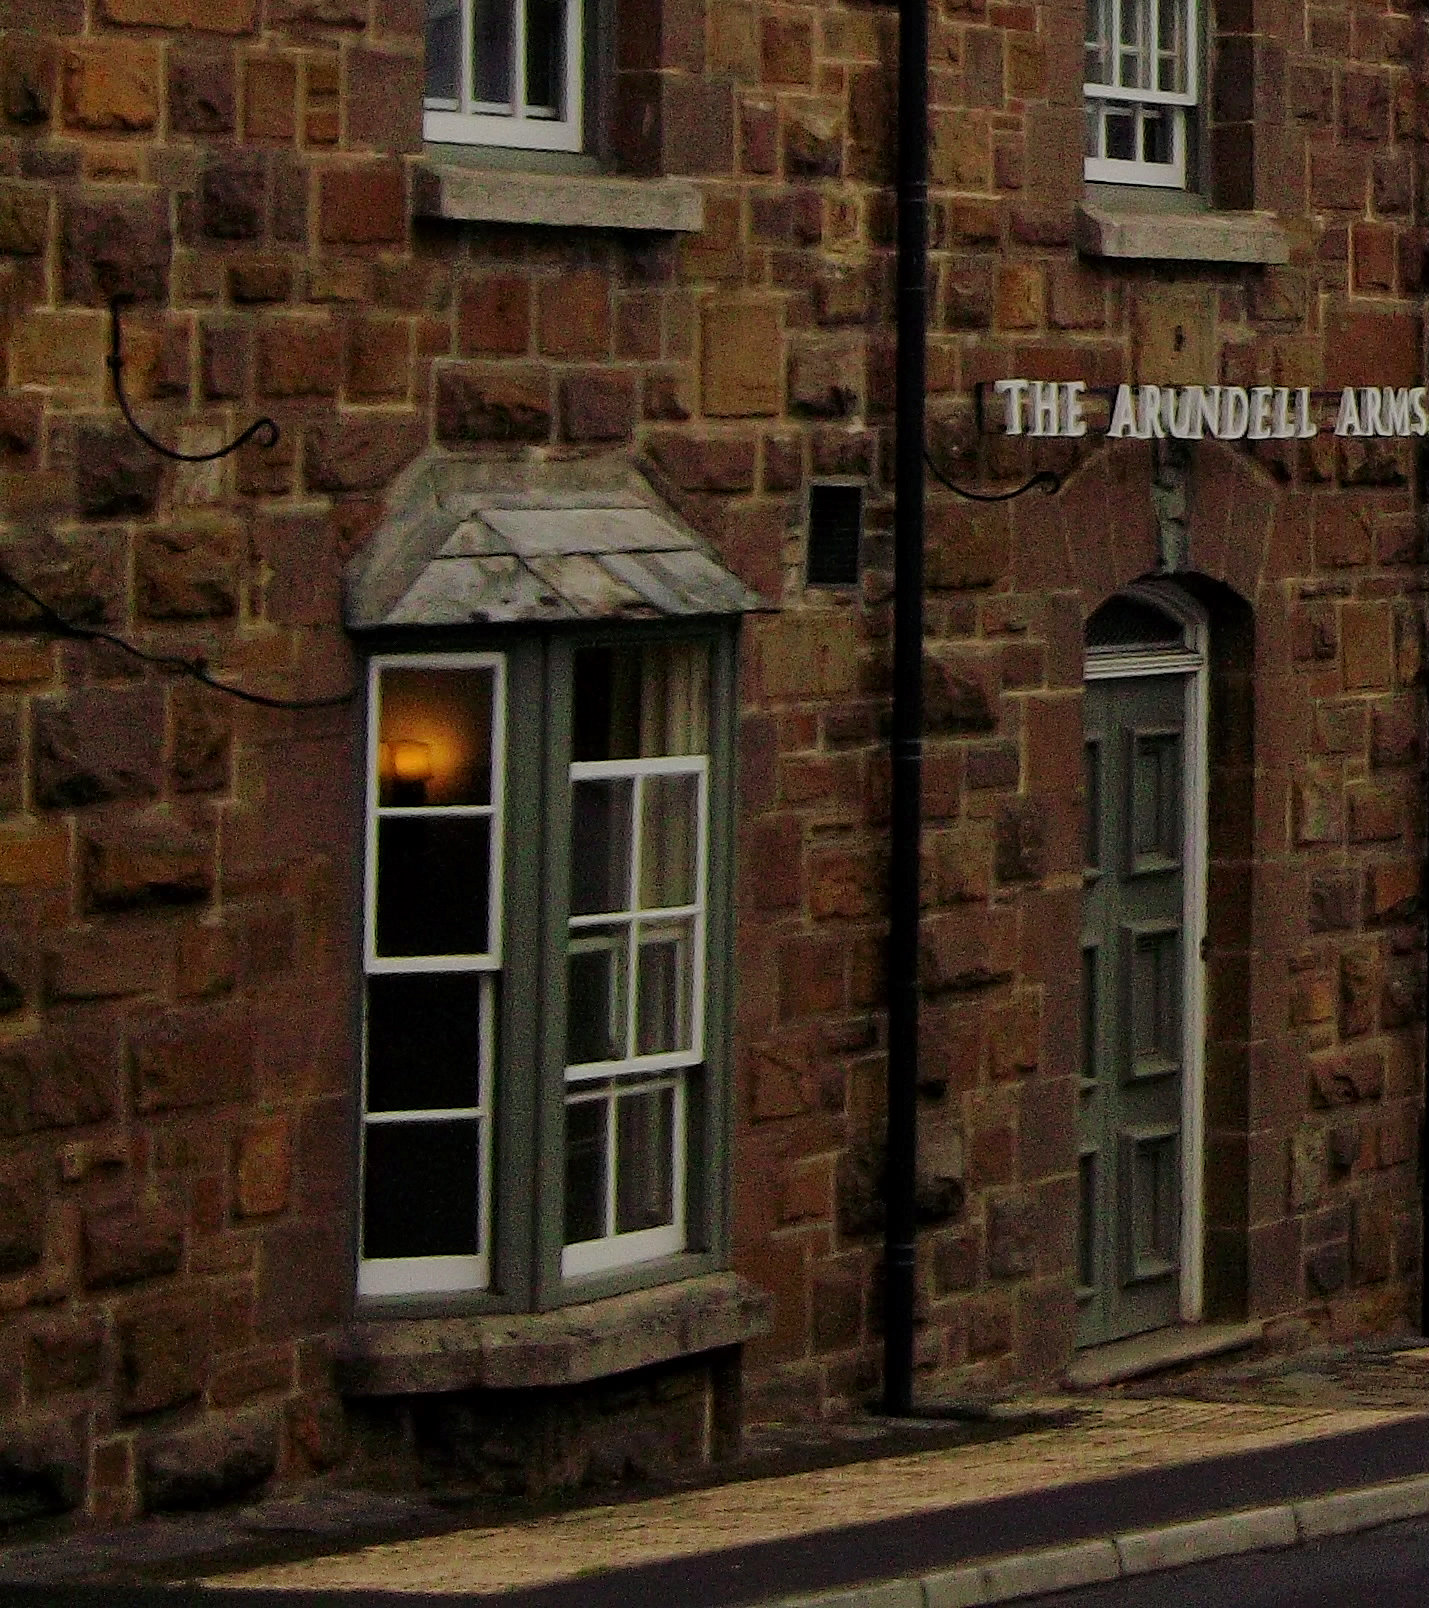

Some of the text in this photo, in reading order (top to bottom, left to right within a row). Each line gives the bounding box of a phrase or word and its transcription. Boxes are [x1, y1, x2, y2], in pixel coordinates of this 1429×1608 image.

[995, 380, 1429, 439] THE ARUNDELL ARMS
